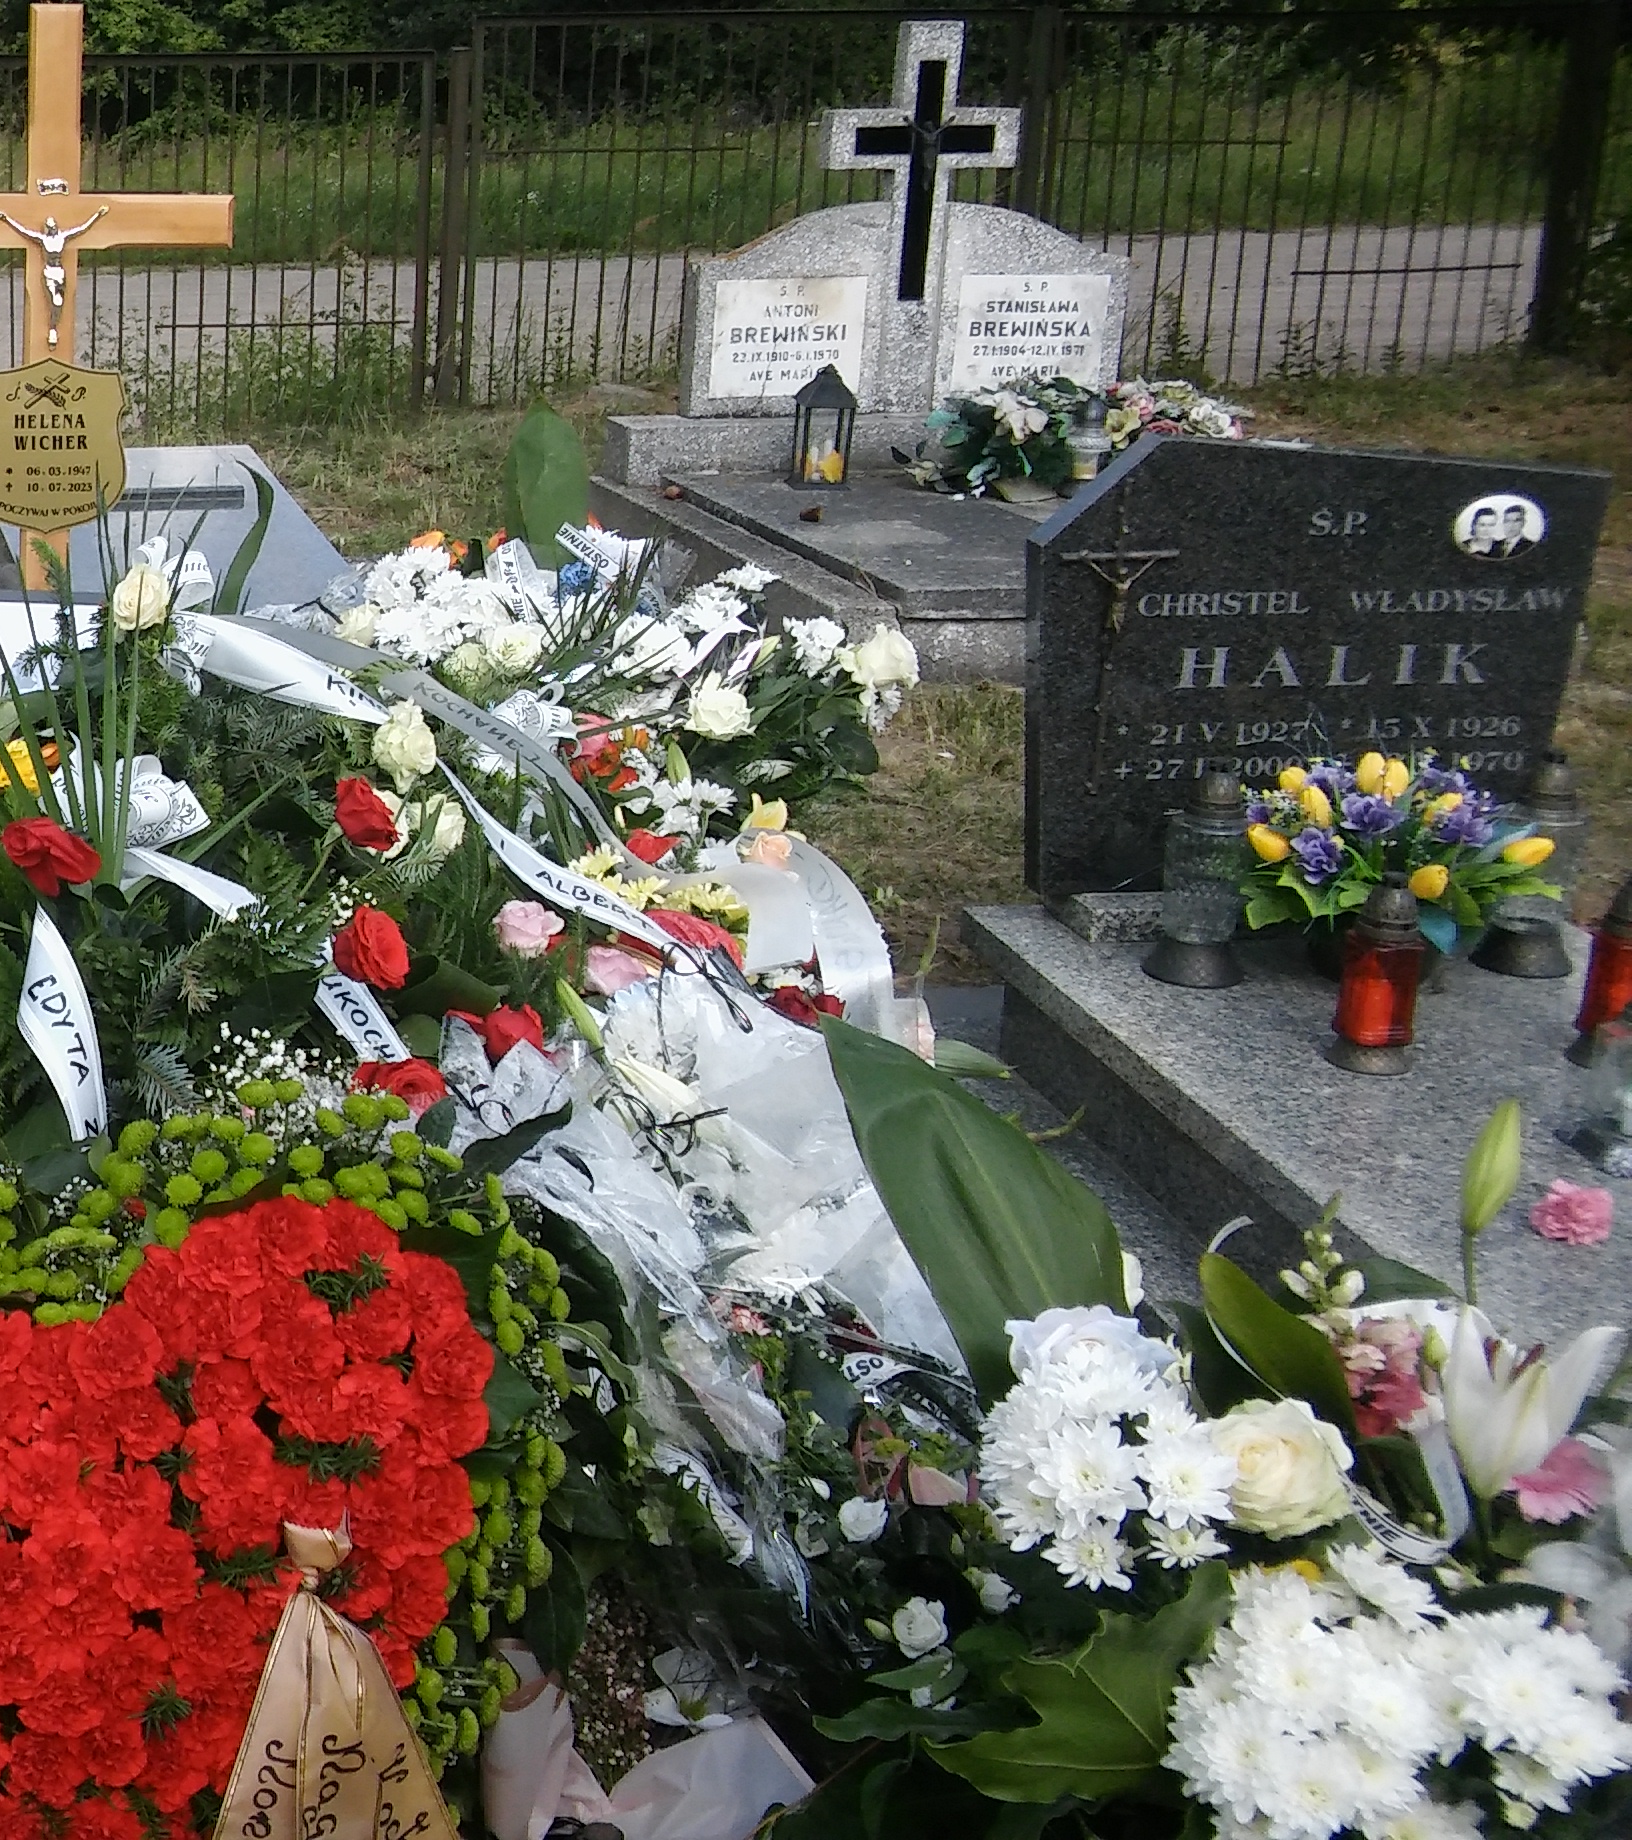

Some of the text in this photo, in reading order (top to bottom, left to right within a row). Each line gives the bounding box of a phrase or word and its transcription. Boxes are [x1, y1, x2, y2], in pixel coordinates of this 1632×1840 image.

[765, 304, 819, 318] ANTONI
[986, 301, 1079, 313] STANISŁAWA
[969, 319, 1091, 337] BREWIŃSKA
[750, 368, 813, 381] AVE MARI
[992, 366, 1013, 376] AVE
[14, 414, 86, 429] HELENA
[14, 435, 88, 450] WICHER
[52, 508, 60, 516] W
[558, 527, 609, 569] OSTATNIE
[1136, 591, 1311, 619] CHRISTEL
[1349, 588, 1570, 614] WŁADYSŁAW
[1174, 643, 1488, 690] HALIK
[1150, 720, 1311, 746] 21 V 1927
[1411, 716, 1433, 739] X
[1448, 715, 1521, 738] 1926
[535, 870, 655, 931] ALBERT
[27, 974, 90, 1087] EDYTA
